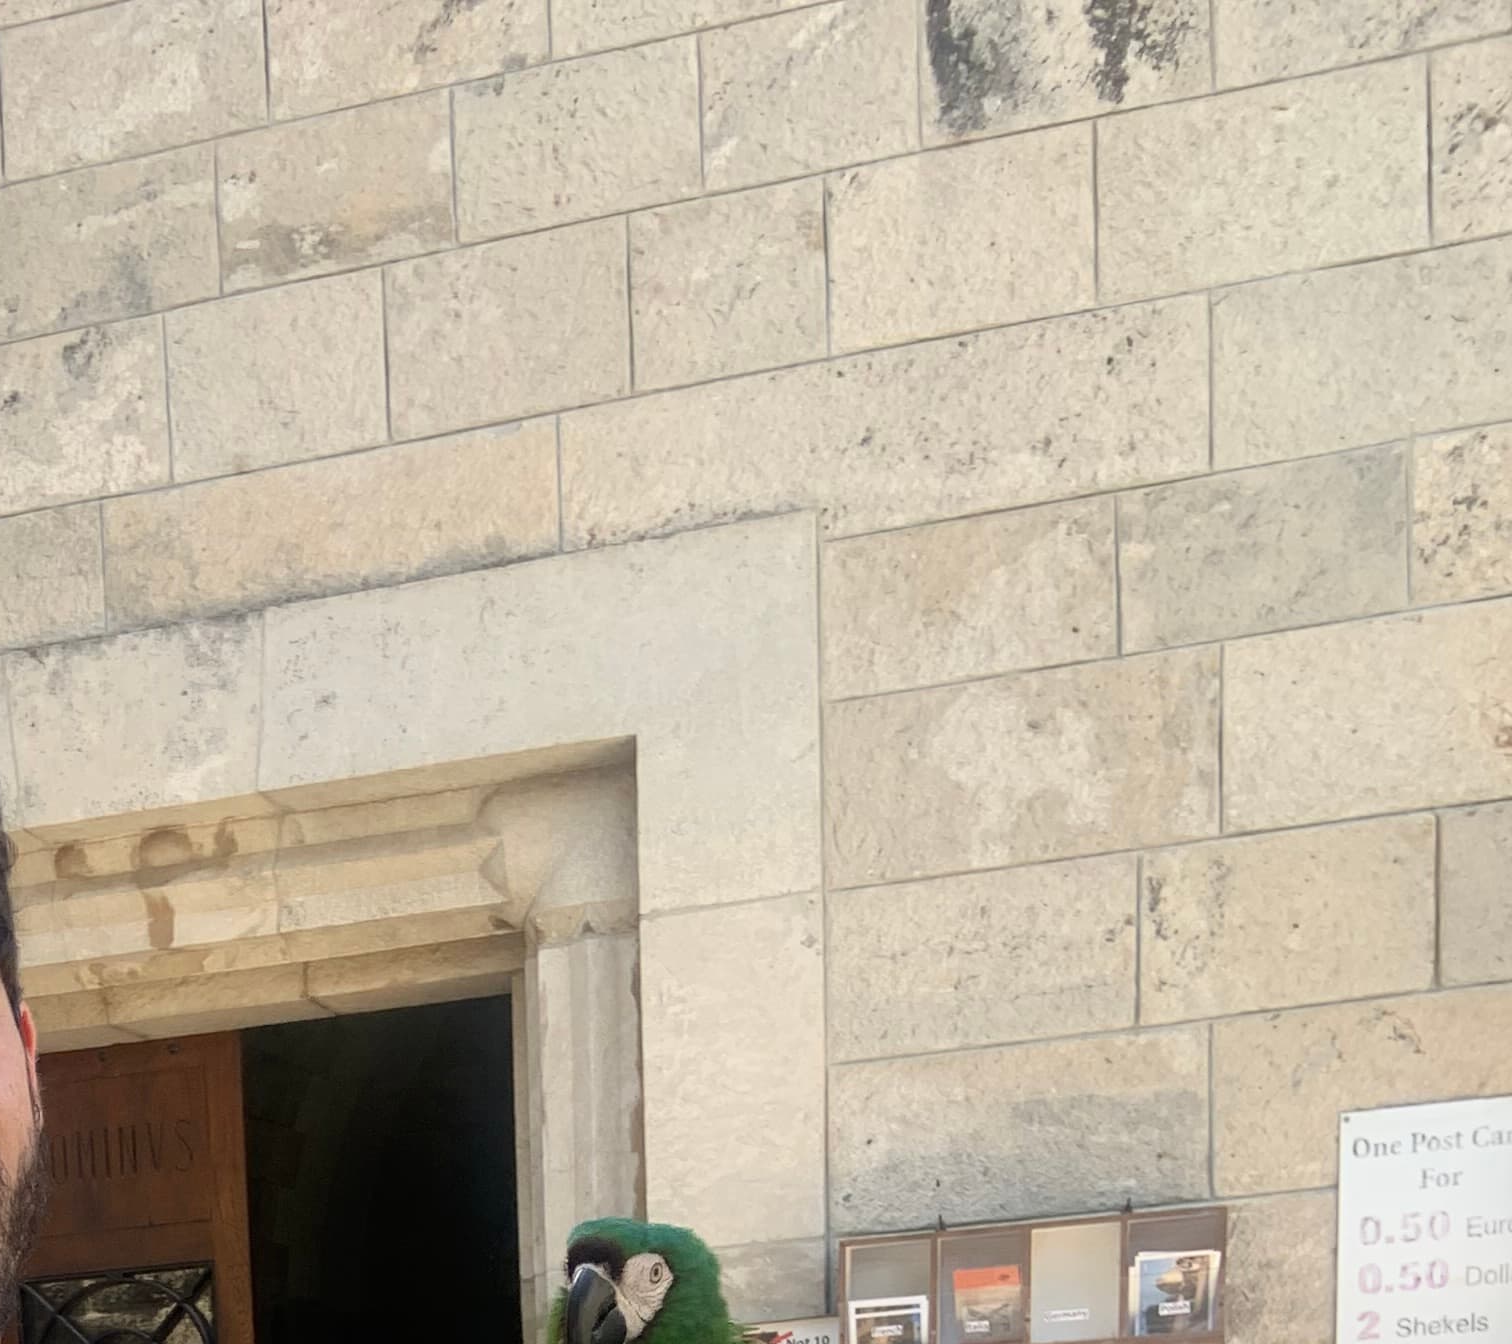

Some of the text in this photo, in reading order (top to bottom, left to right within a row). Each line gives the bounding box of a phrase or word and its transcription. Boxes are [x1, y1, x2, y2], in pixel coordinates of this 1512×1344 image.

[50, 1118, 195, 1186] OMINVS
[1352, 1136, 1402, 1159] One
[1411, 1129, 1464, 1155] Post
[1418, 1167, 1464, 1190] For
[1359, 1210, 1450, 1246] 0.50
[1357, 1259, 1512, 1294] 0.50 Doll
[1356, 1310, 1490, 1341] 2 Shekels
